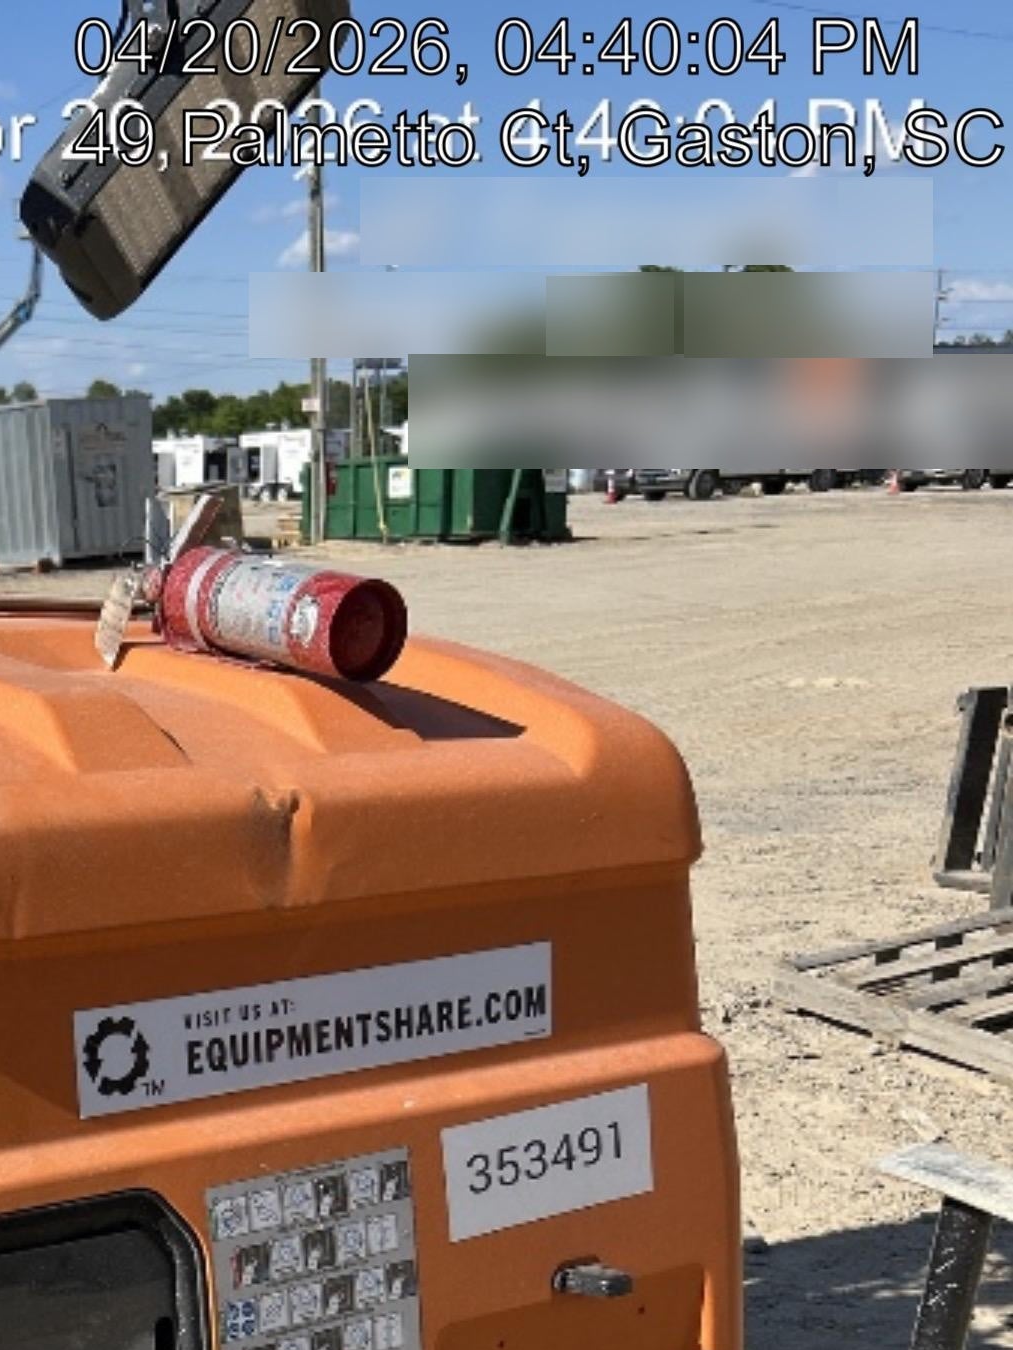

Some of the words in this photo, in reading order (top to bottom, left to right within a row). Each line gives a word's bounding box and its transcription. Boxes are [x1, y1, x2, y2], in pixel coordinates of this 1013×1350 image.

[186, 983, 547, 1075] EQUIPMENTSHARE.COM
[238, 1004, 261, 1021] US
[466, 1121, 622, 1194] 353491
